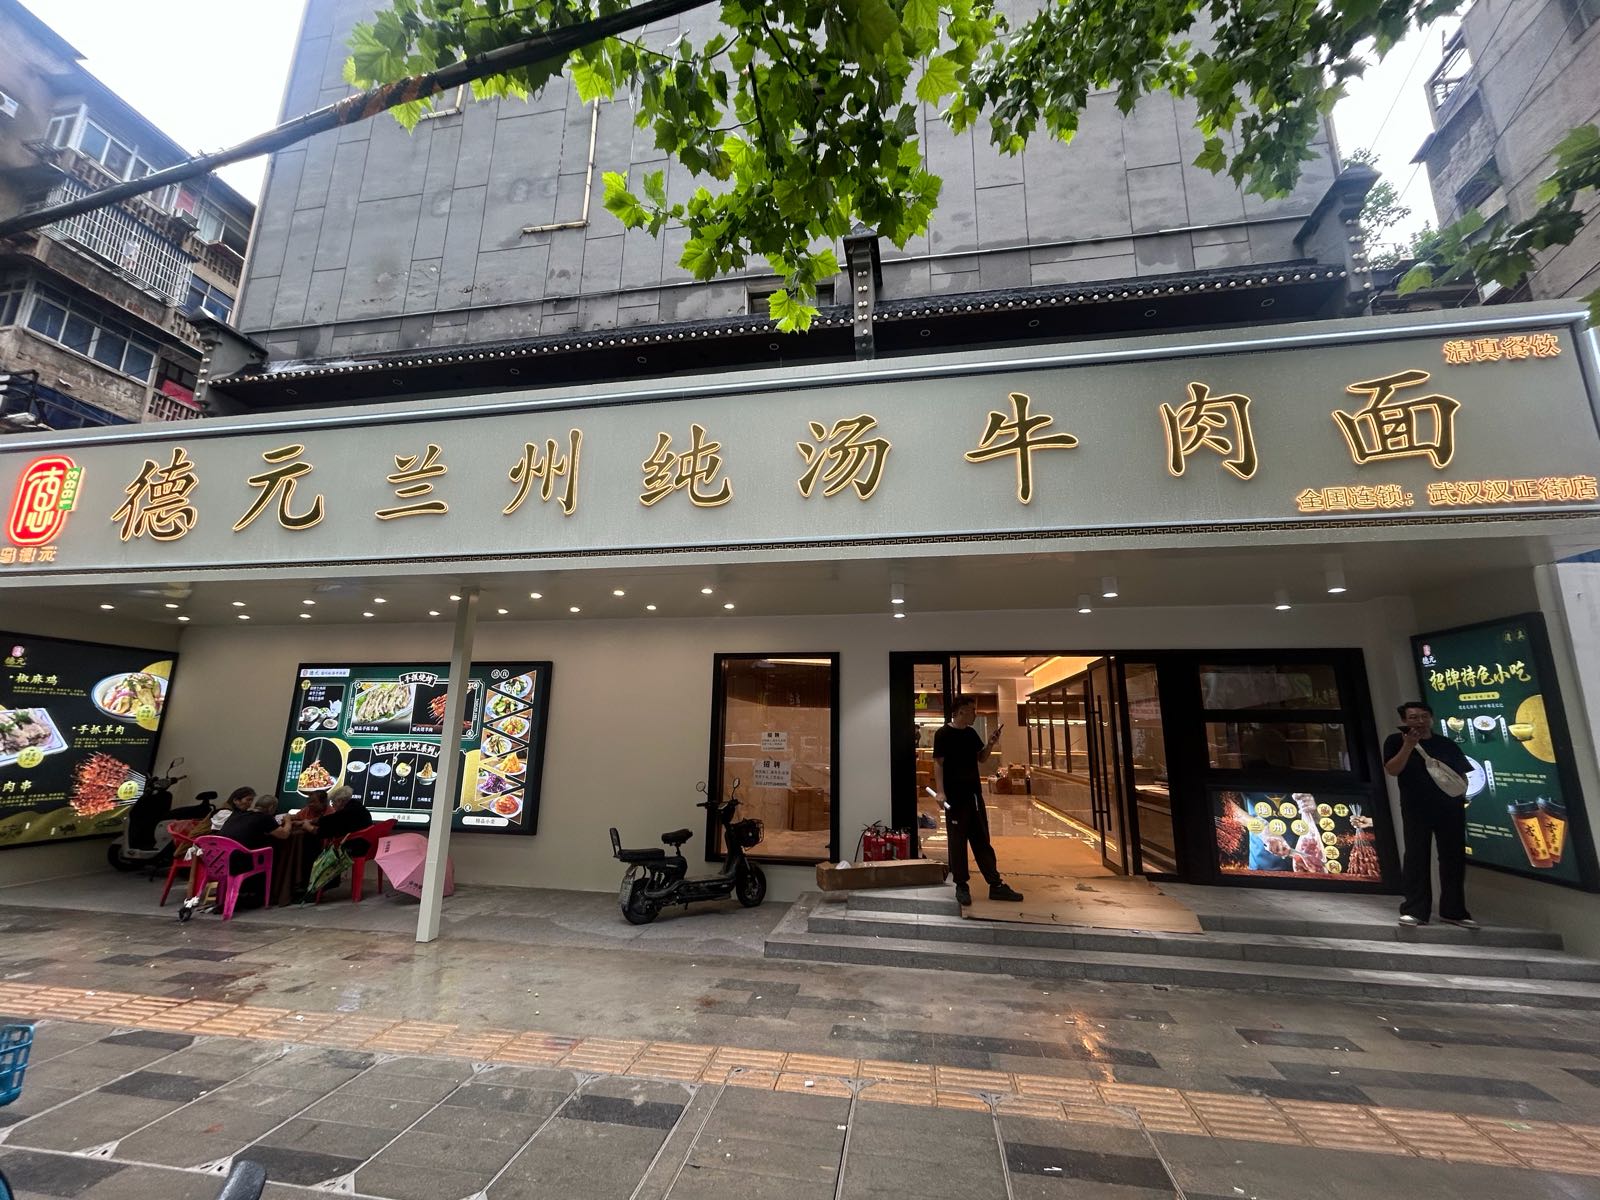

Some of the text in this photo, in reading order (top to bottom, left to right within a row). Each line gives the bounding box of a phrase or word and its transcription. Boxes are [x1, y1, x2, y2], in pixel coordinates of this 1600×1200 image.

[1443, 333, 1562, 364] 清真餐饮
[110, 368, 1463, 543] 德元兰州纯汤牛肉面
[15, 672, 59, 686] 椒麻鸡
[1428, 660, 1532, 693] 招牌特色小吃
[77, 724, 126, 736] 手抓羊肉
[378, 741, 436, 756] 西北特色小吃系列
[763, 760, 780, 768] 招聘
